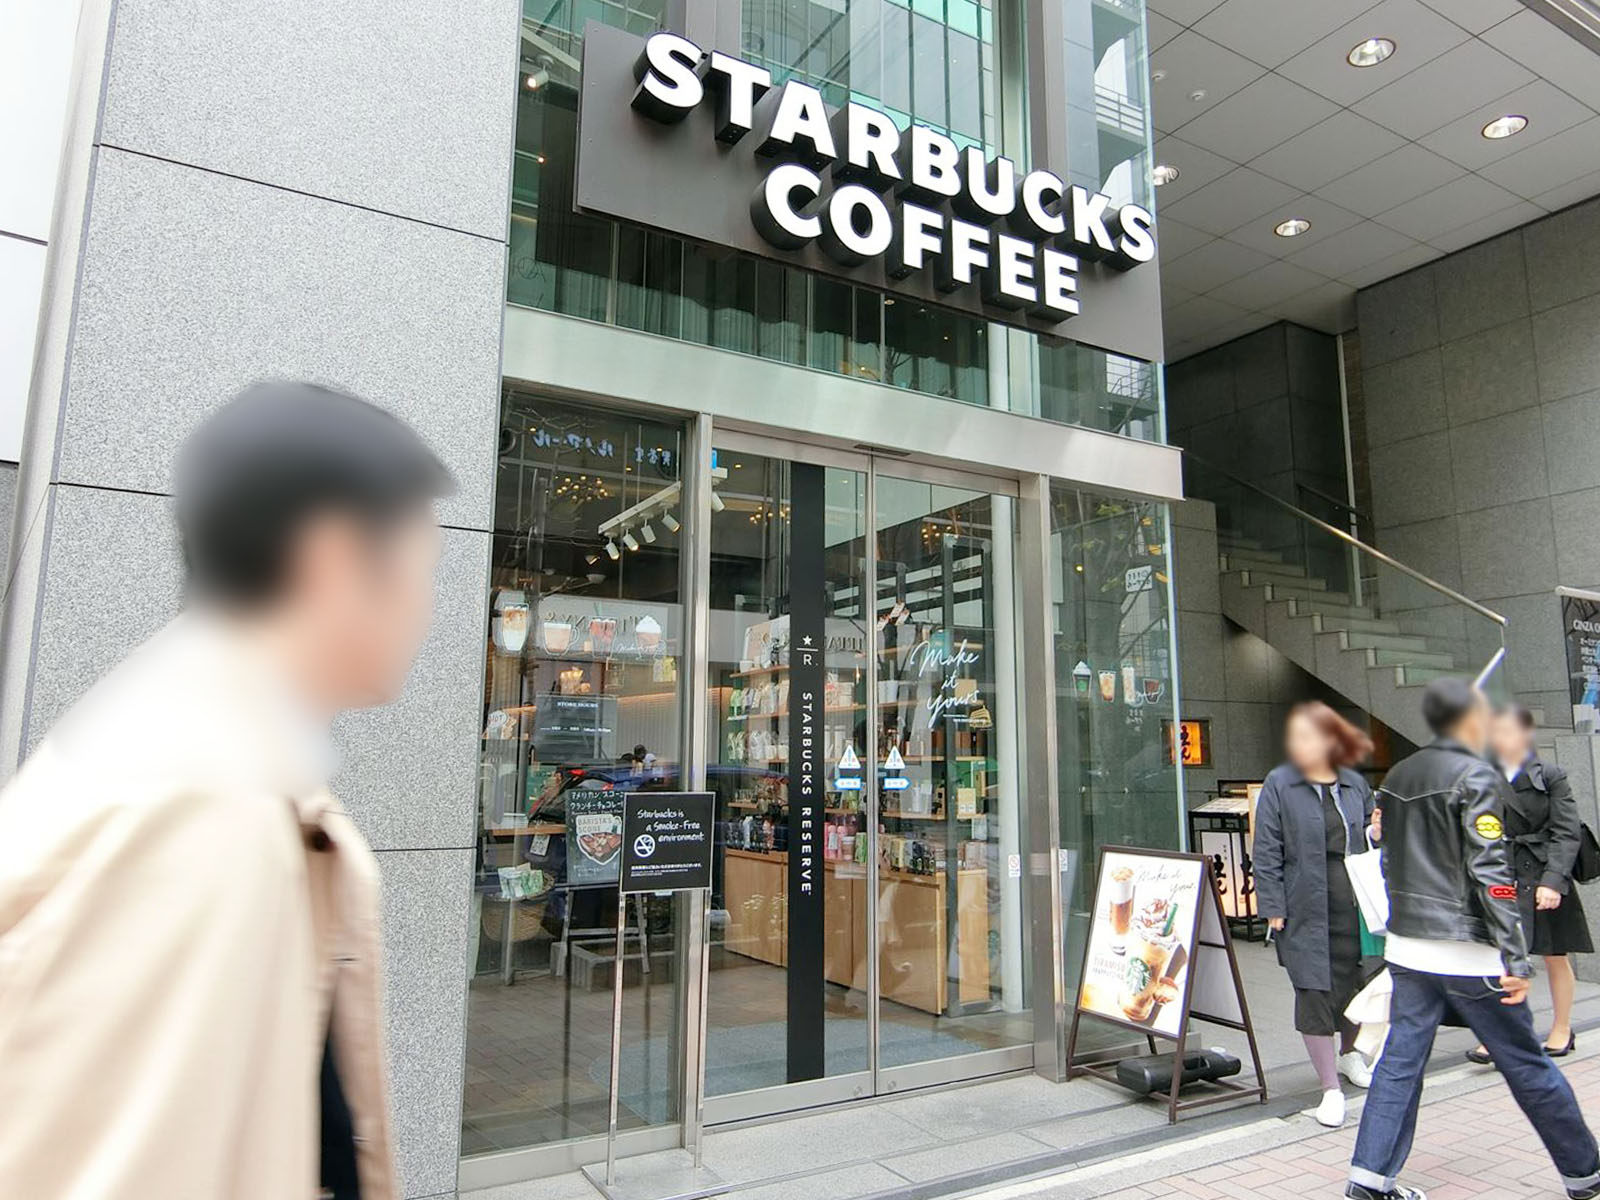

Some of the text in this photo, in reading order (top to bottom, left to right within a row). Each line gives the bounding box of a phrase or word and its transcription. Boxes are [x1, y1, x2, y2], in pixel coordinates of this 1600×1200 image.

[641, 32, 1157, 264] STARBUCKS
[763, 163, 1080, 315] COFFEE
[910, 638, 980, 678] Make
[941, 669, 960, 690] it
[801, 692, 813, 892] STARBUCKS RESERVE
[637, 808, 684, 819] Starbucks is
[645, 824, 653, 832] a
[658, 832, 704, 843] environment
